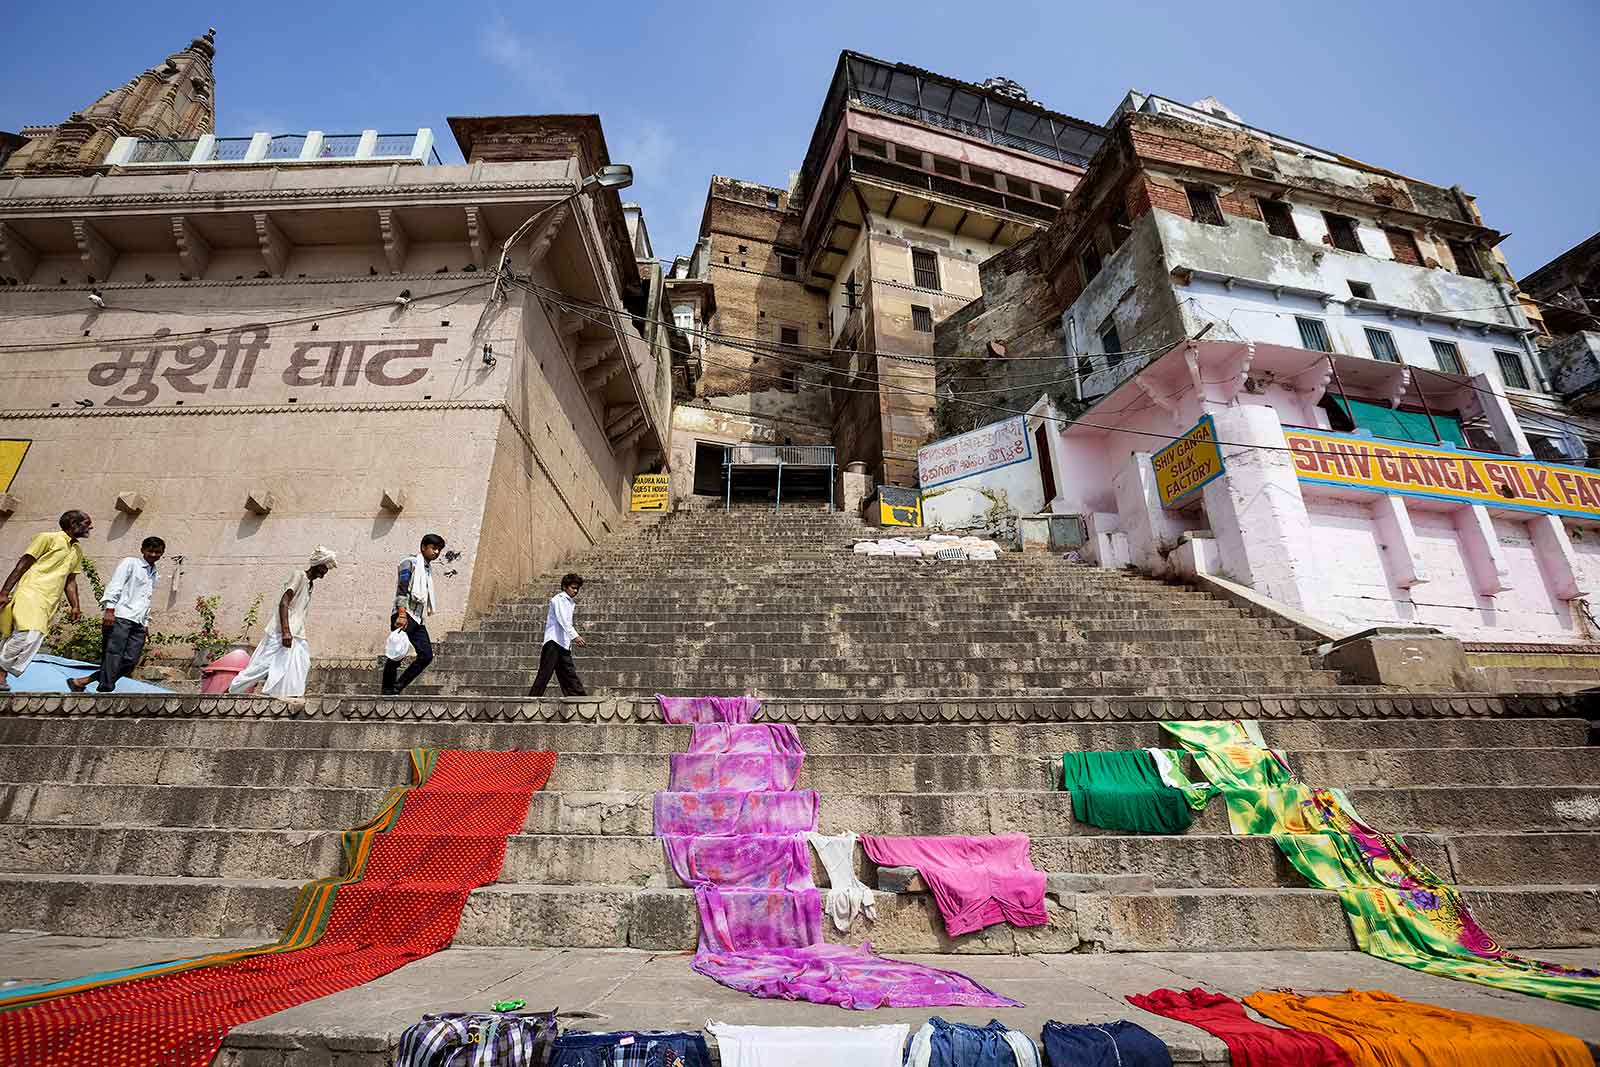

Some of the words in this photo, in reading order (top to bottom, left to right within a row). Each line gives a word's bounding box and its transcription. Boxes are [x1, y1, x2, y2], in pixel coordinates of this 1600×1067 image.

[87, 323, 271, 406] मुंशी
[281, 338, 448, 387] घाट
[1155, 450, 1175, 471] SHIV
[1177, 426, 1210, 456] GANGA
[1170, 453, 1196, 477] SILK
[1288, 437, 1371, 479] SHIV
[1374, 447, 1488, 494] GANGA
[1484, 463, 1561, 502] SILK
[633, 485, 651, 493] GUEST
[1166, 459, 1211, 498] FACTORY
